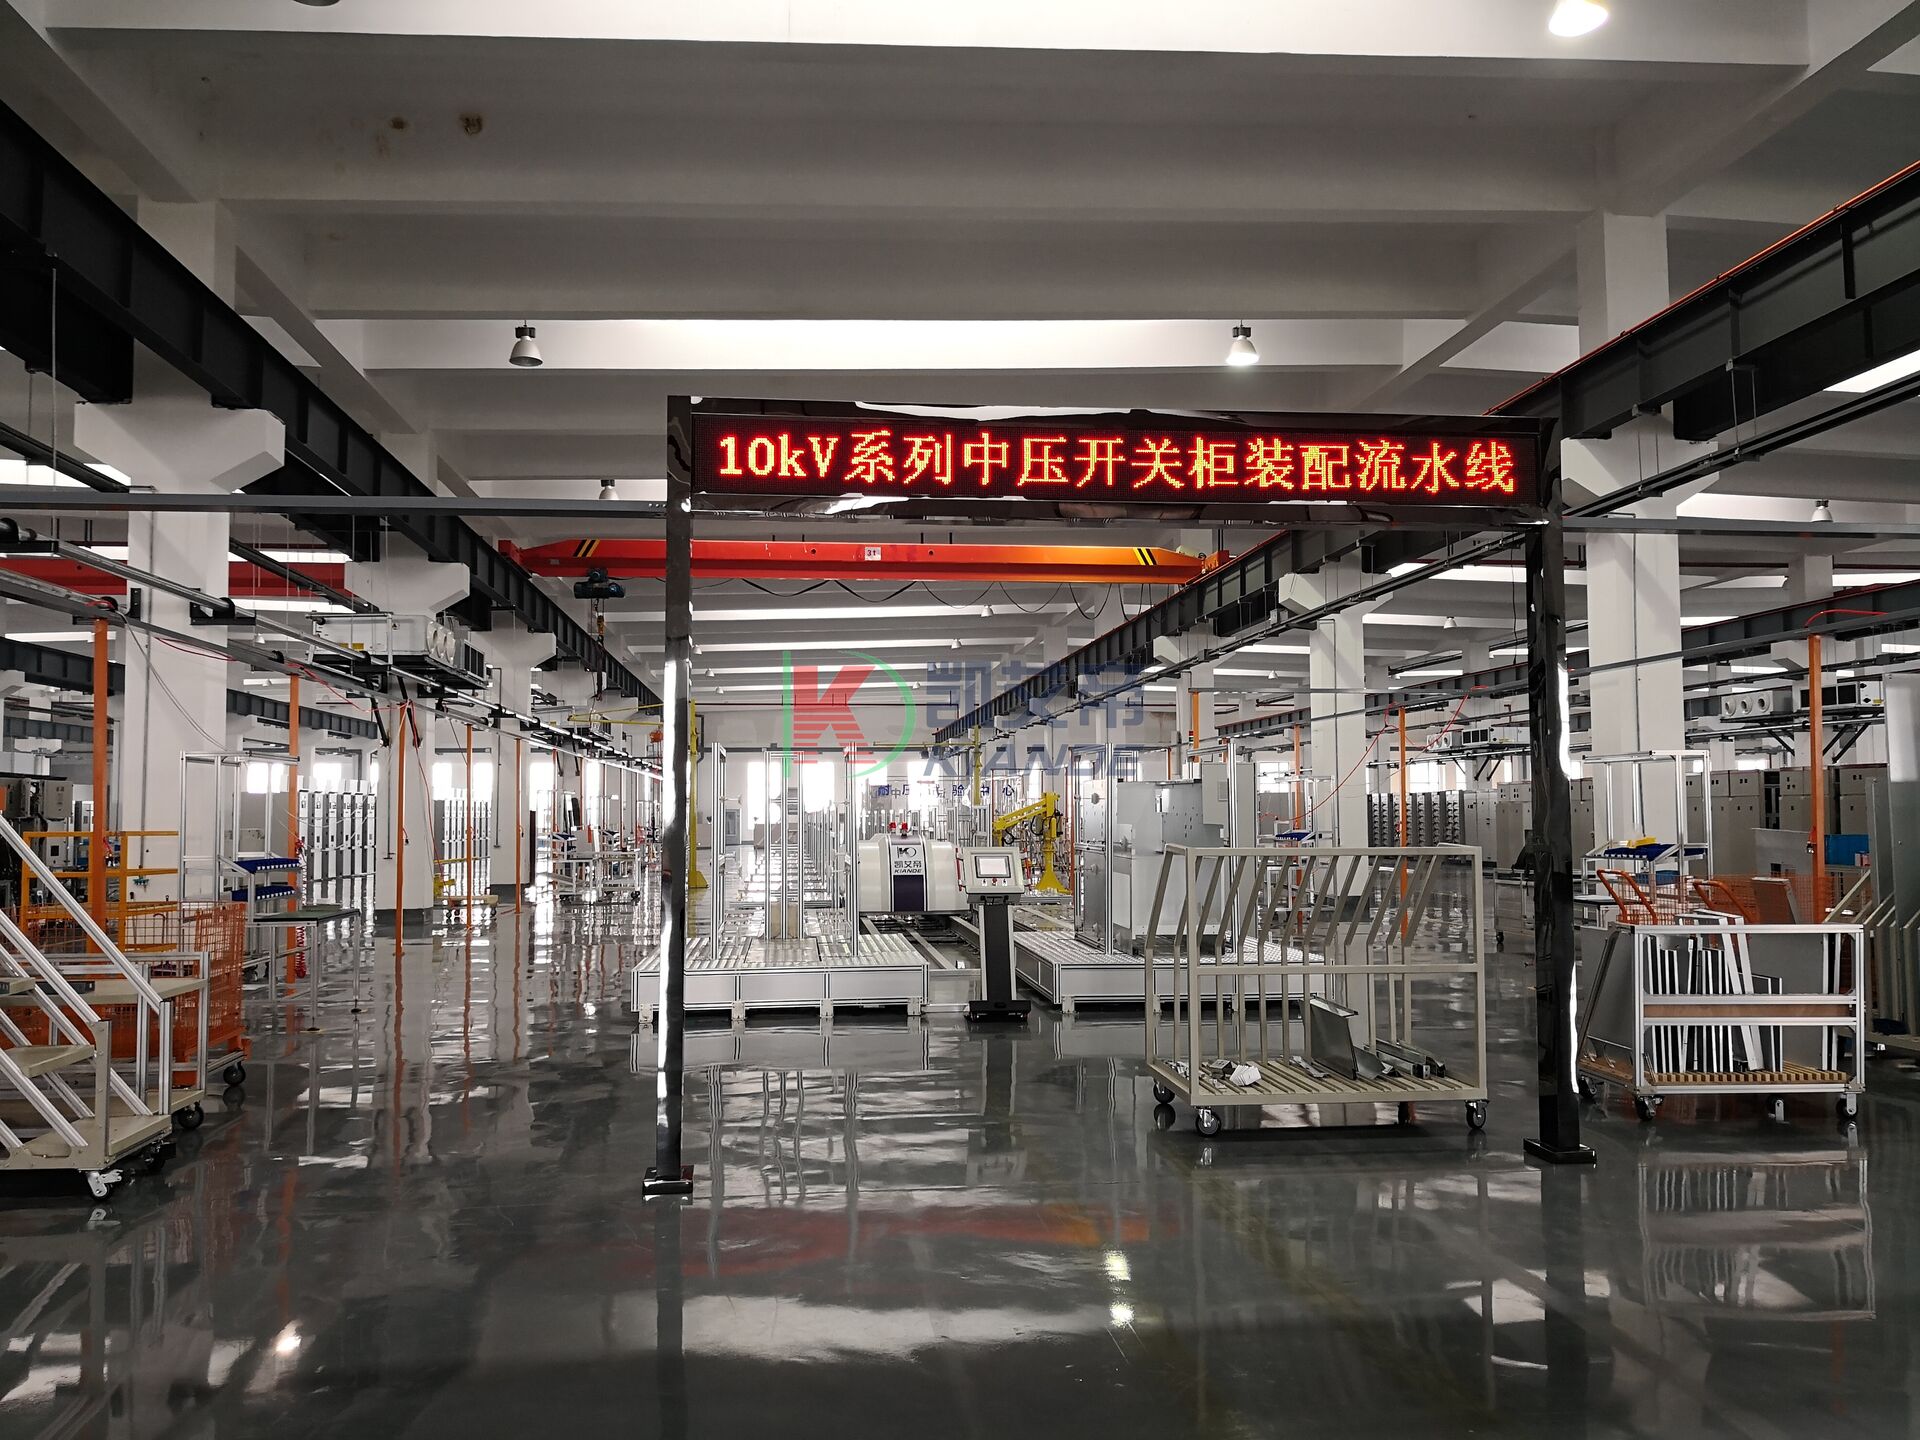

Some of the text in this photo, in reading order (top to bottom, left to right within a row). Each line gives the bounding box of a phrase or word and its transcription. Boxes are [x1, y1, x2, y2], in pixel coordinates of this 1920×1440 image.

[720, 430, 1513, 492] 10kV系列中压开关柜装配流水线
